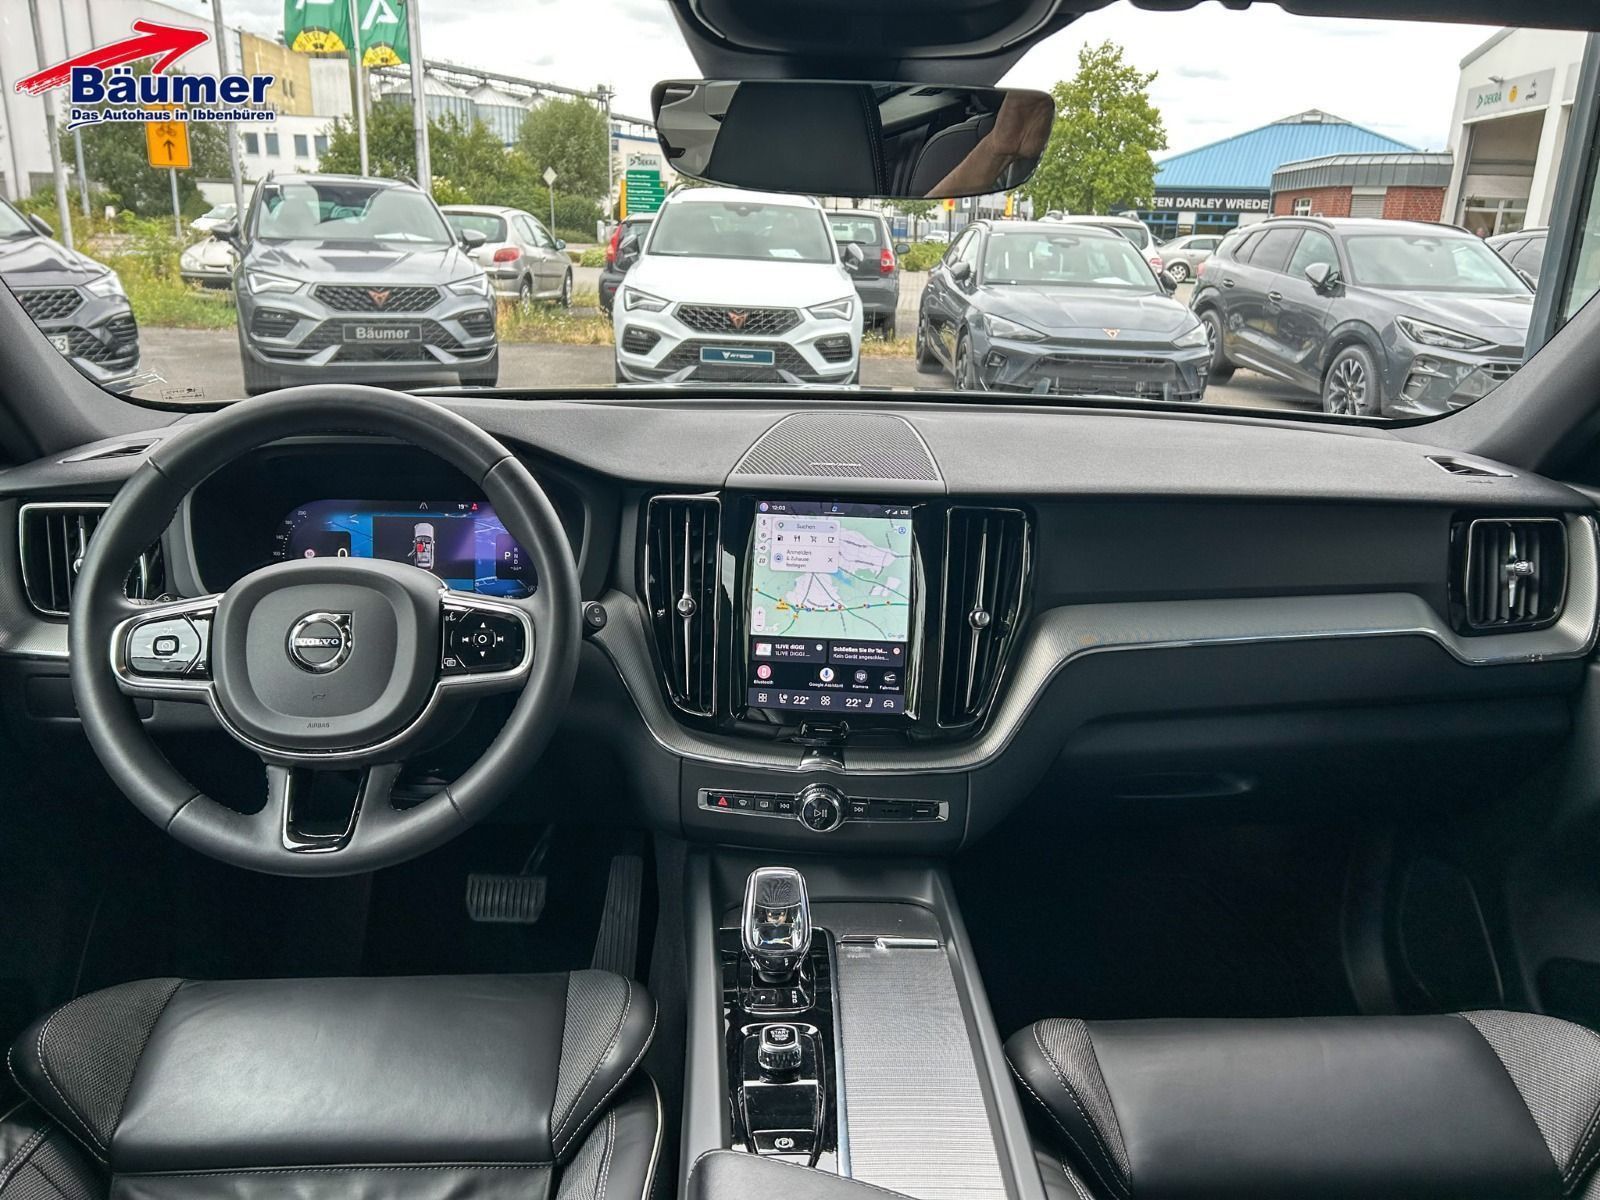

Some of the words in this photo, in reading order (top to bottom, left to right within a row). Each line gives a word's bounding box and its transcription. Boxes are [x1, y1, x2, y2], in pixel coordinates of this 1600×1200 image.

[1175, 197, 1223, 209] DARLEY
[1225, 199, 1270, 210] WREDE
[355, 327, 410, 339] Bäumer
[504, 551, 511, 560] P
[298, 638, 340, 646] VOLVO
